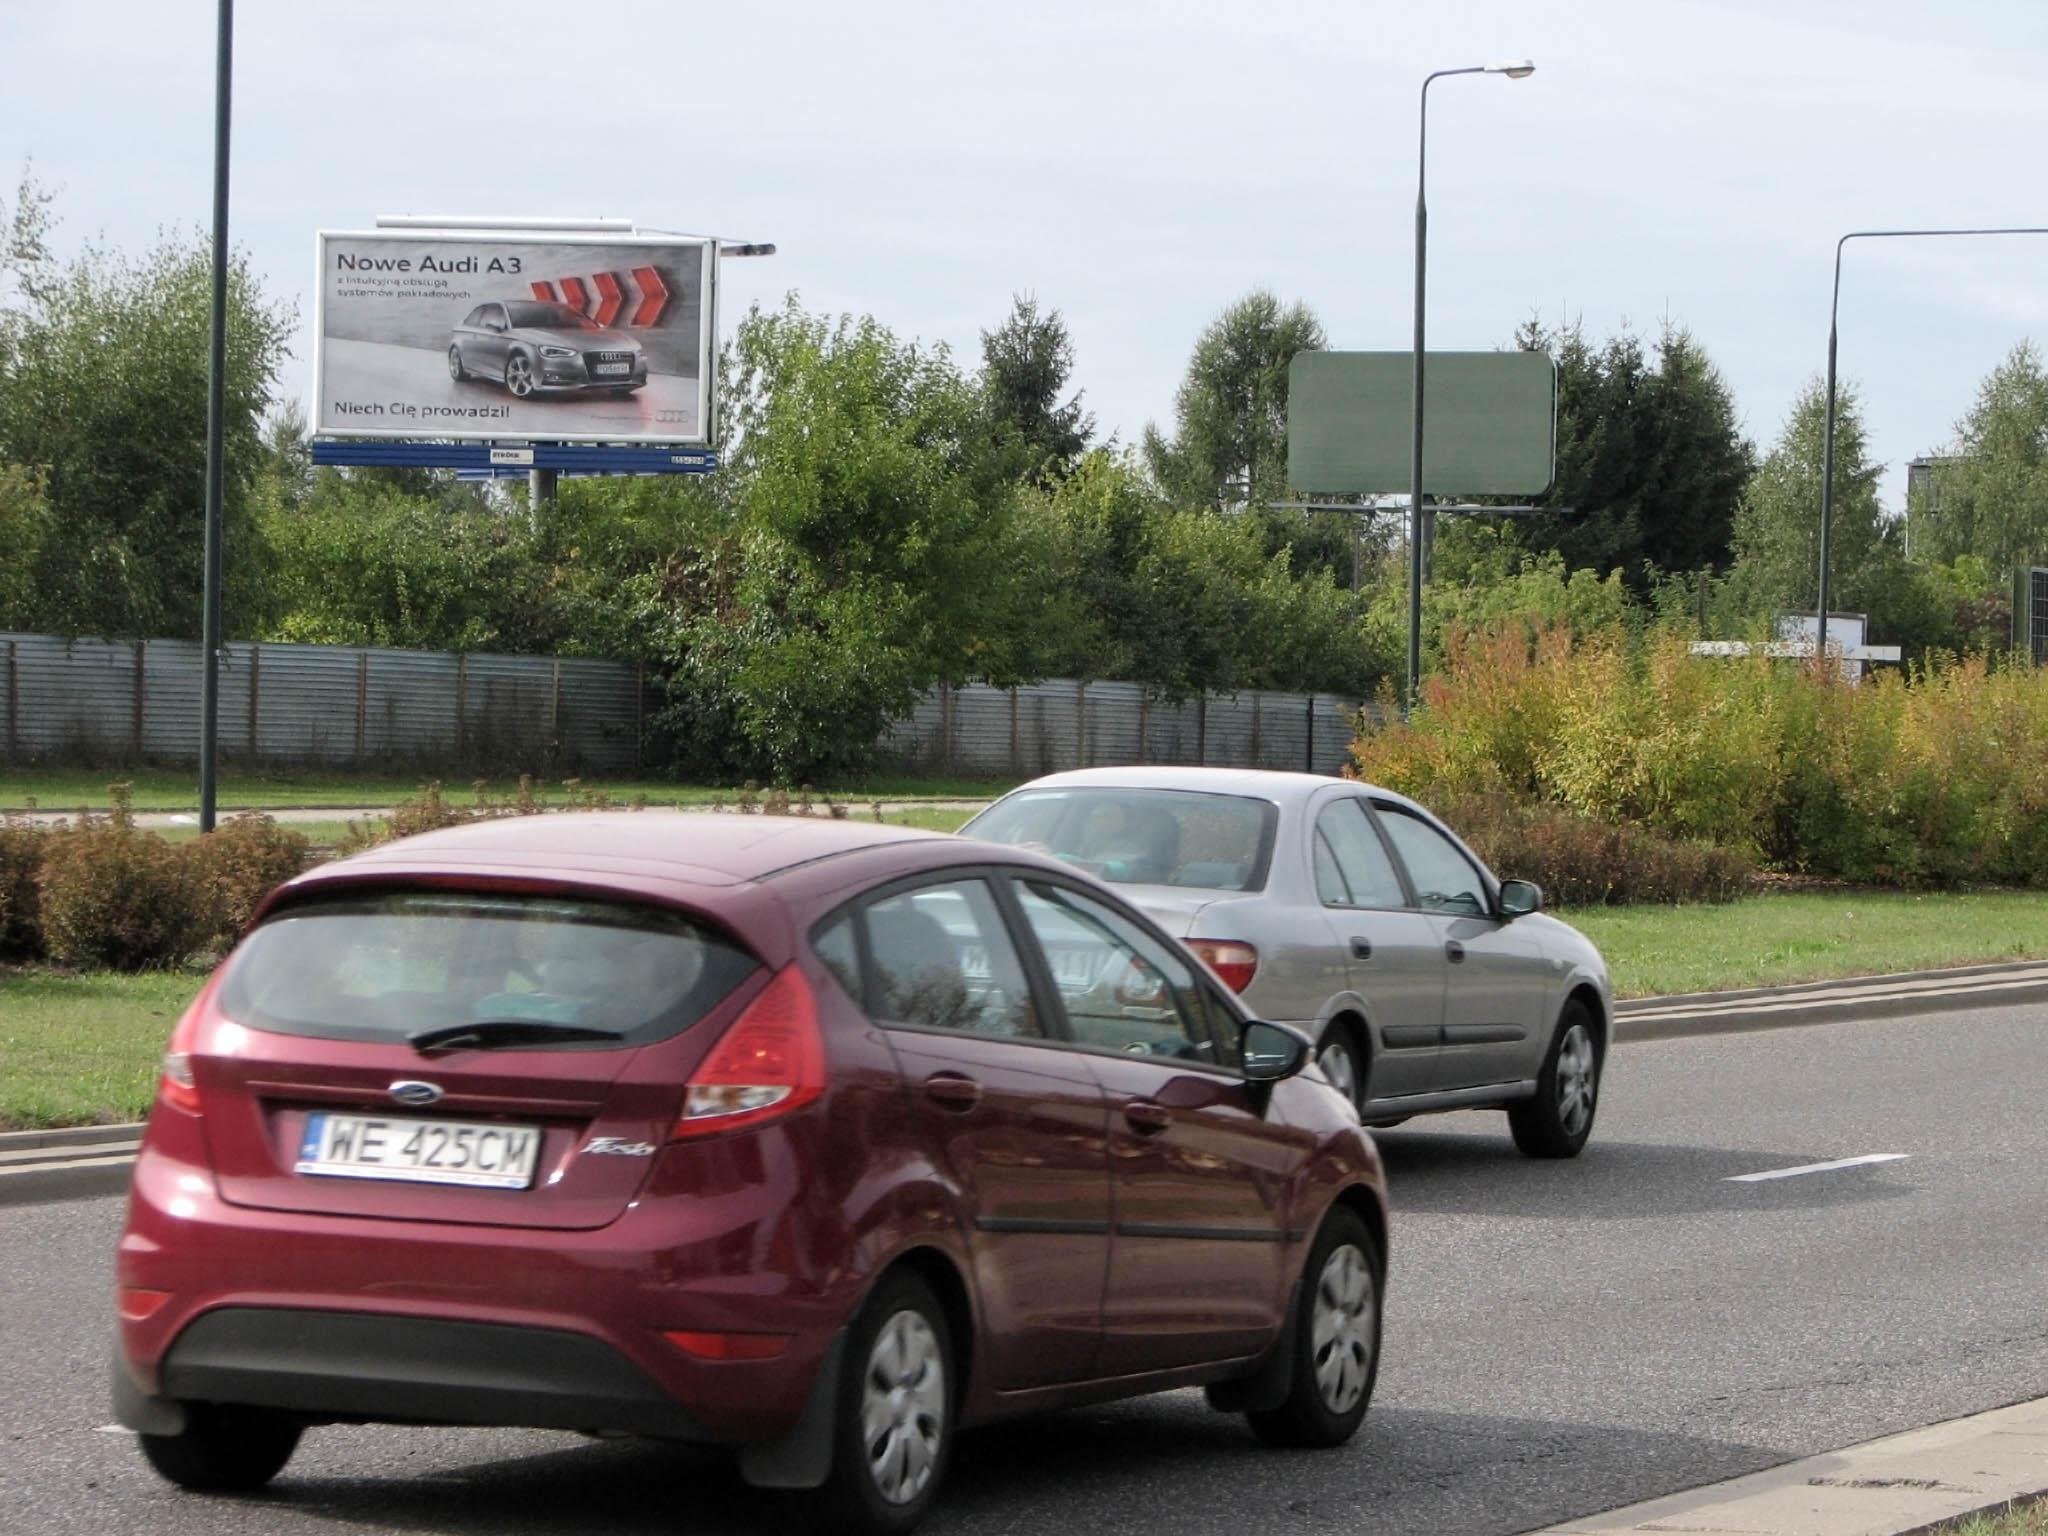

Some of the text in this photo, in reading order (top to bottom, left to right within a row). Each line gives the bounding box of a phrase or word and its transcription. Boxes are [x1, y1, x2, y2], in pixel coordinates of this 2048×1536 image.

[337, 253, 522, 274] Nowe Audi A3
[402, 278, 448, 288] obsługą
[337, 288, 471, 300] systemów pokładowych
[334, 402, 510, 419] Niech Cię prowadzi!
[328, 1118, 532, 1174] WE 425CM
